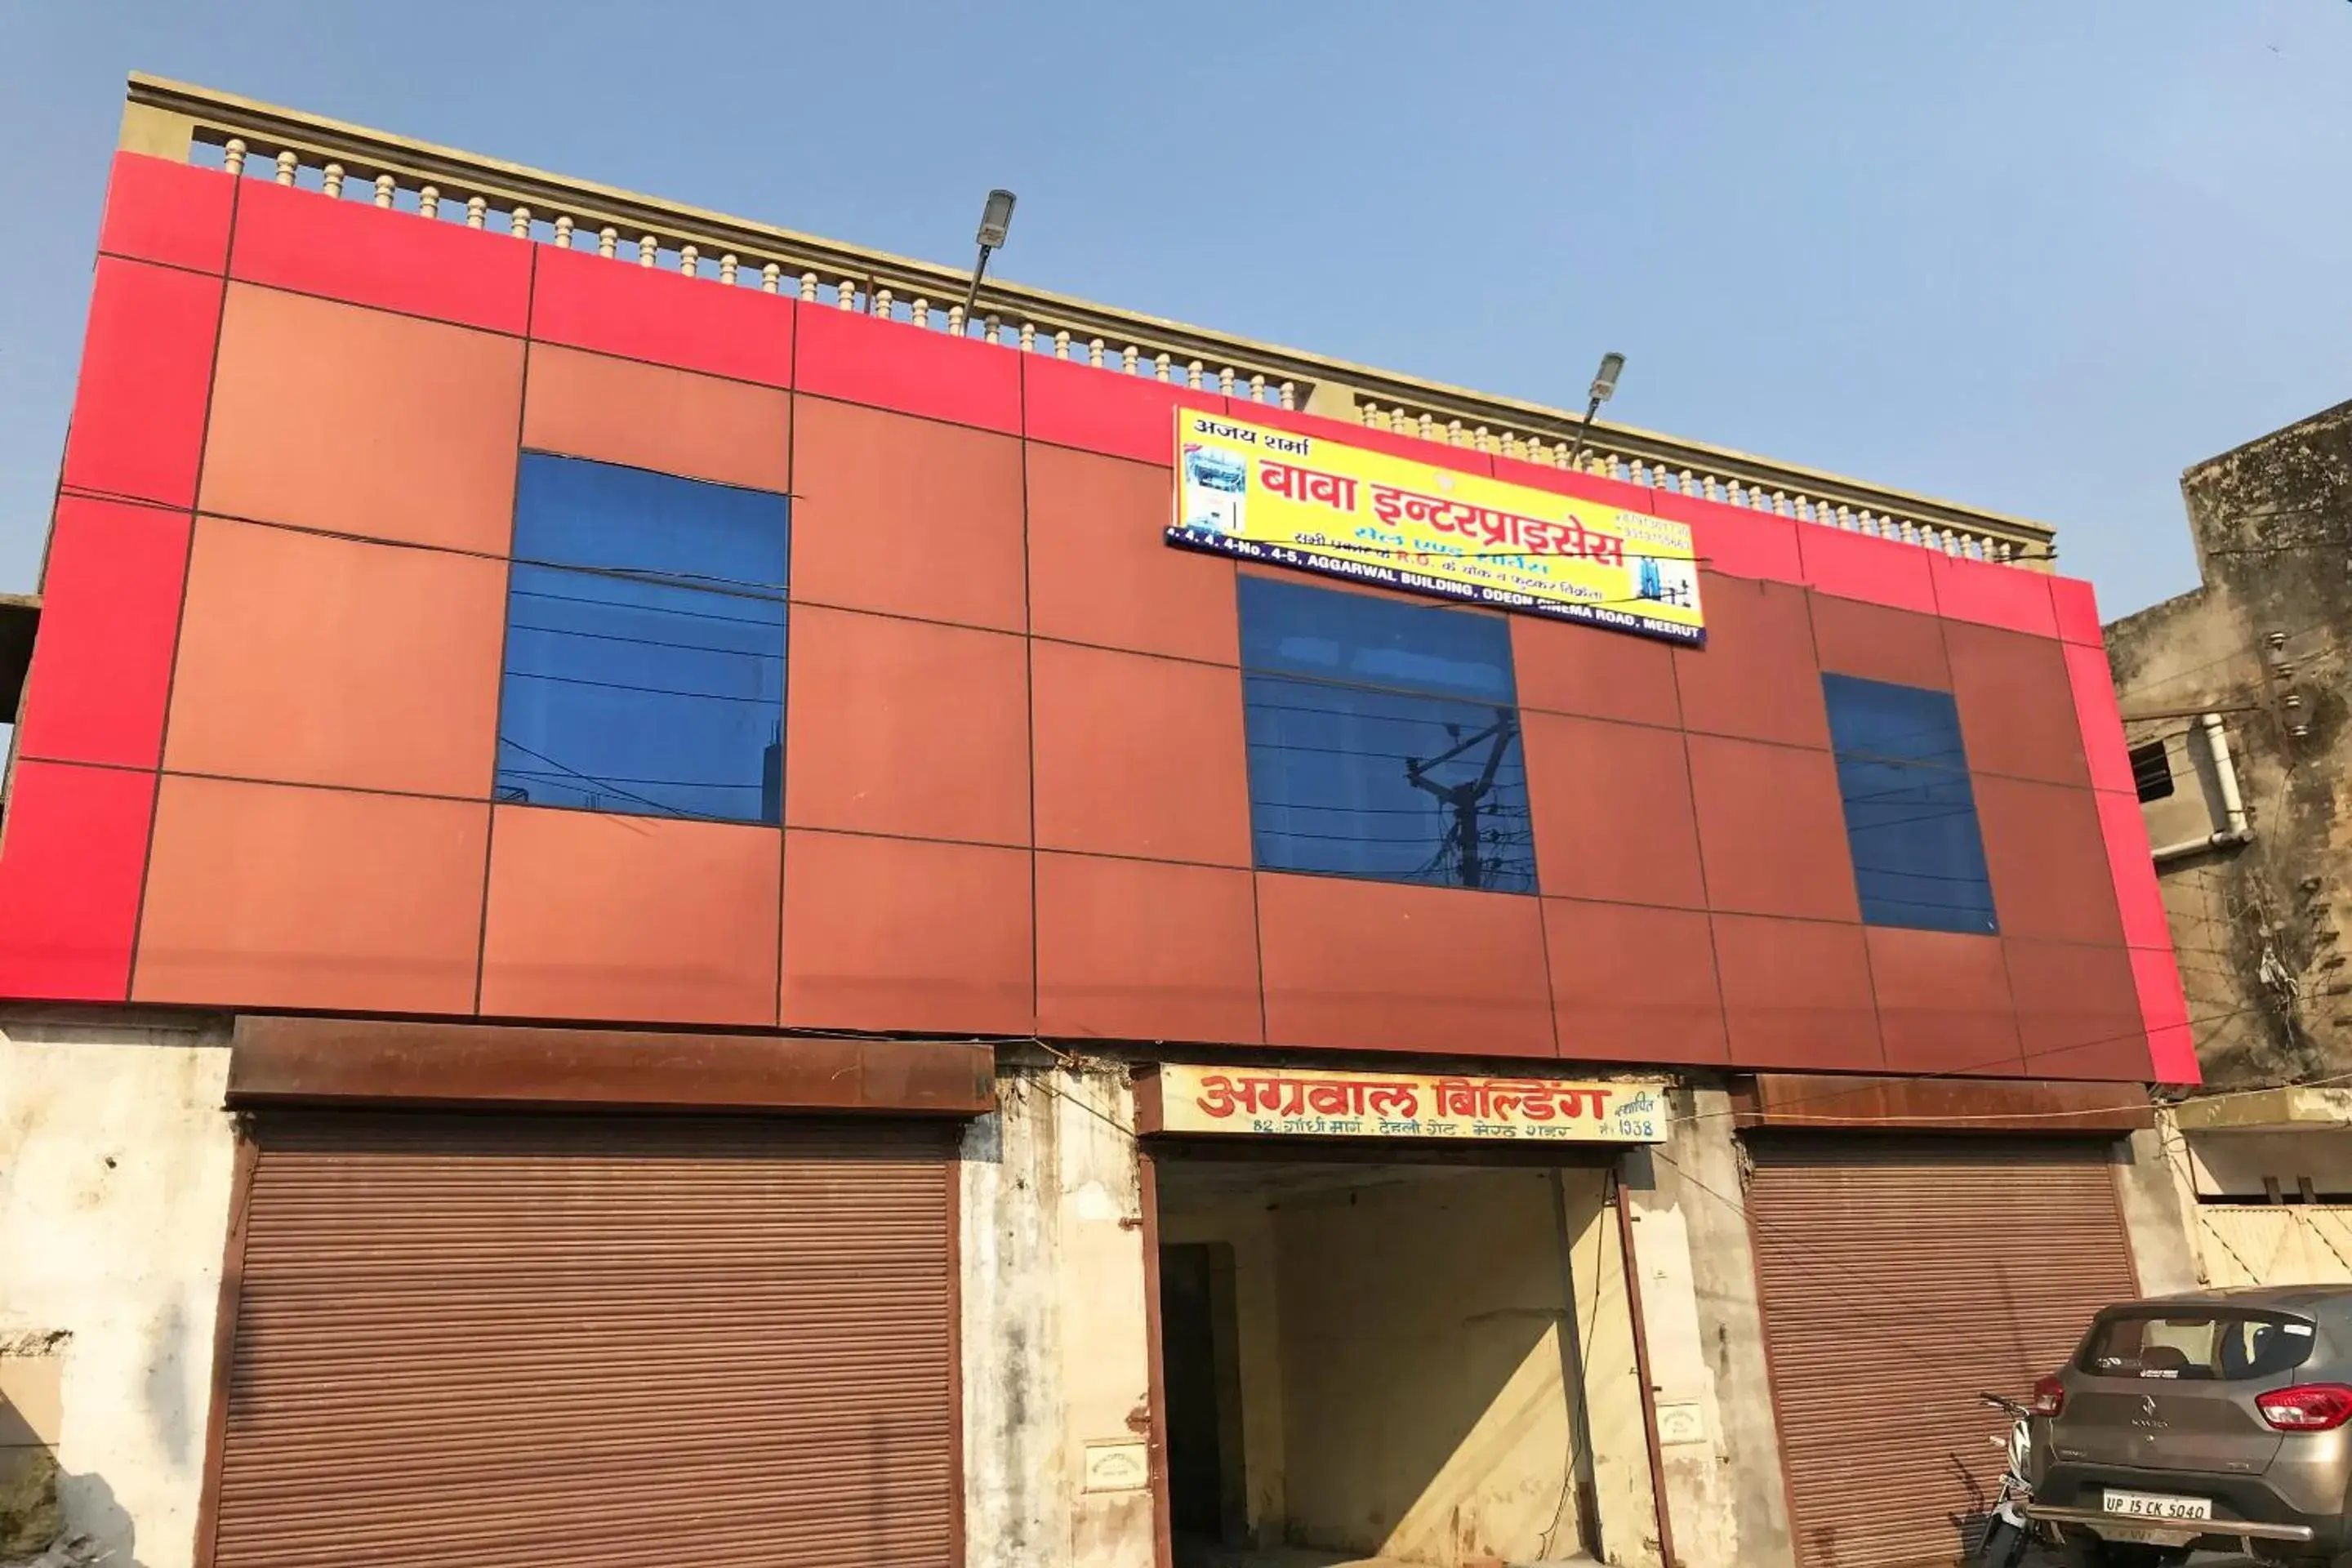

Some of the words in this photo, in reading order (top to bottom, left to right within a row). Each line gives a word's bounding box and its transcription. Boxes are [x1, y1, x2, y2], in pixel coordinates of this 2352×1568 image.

[1194, 419, 1256, 443] अजय
[1265, 435, 1310, 456] शर्मा
[1259, 459, 1358, 511] बाबा
[1370, 484, 1624, 567] इन्टरप्राइसेस
[1307, 555, 1397, 582] AGGARWAL
[1401, 573, 1479, 599] BUILDING,
[1482, 589, 1534, 606] ODEON
[1643, 621, 1700, 639] MEERUT
[1196, 1075, 1419, 1119] अग्रवाल
[1431, 1078, 1612, 1121] बिल्डिंग
[2106, 1497, 2123, 1511] UP
[2130, 1499, 2142, 1513] 15
[2146, 1501, 2163, 1515] CK
[2168, 1504, 2204, 1519] 5040
